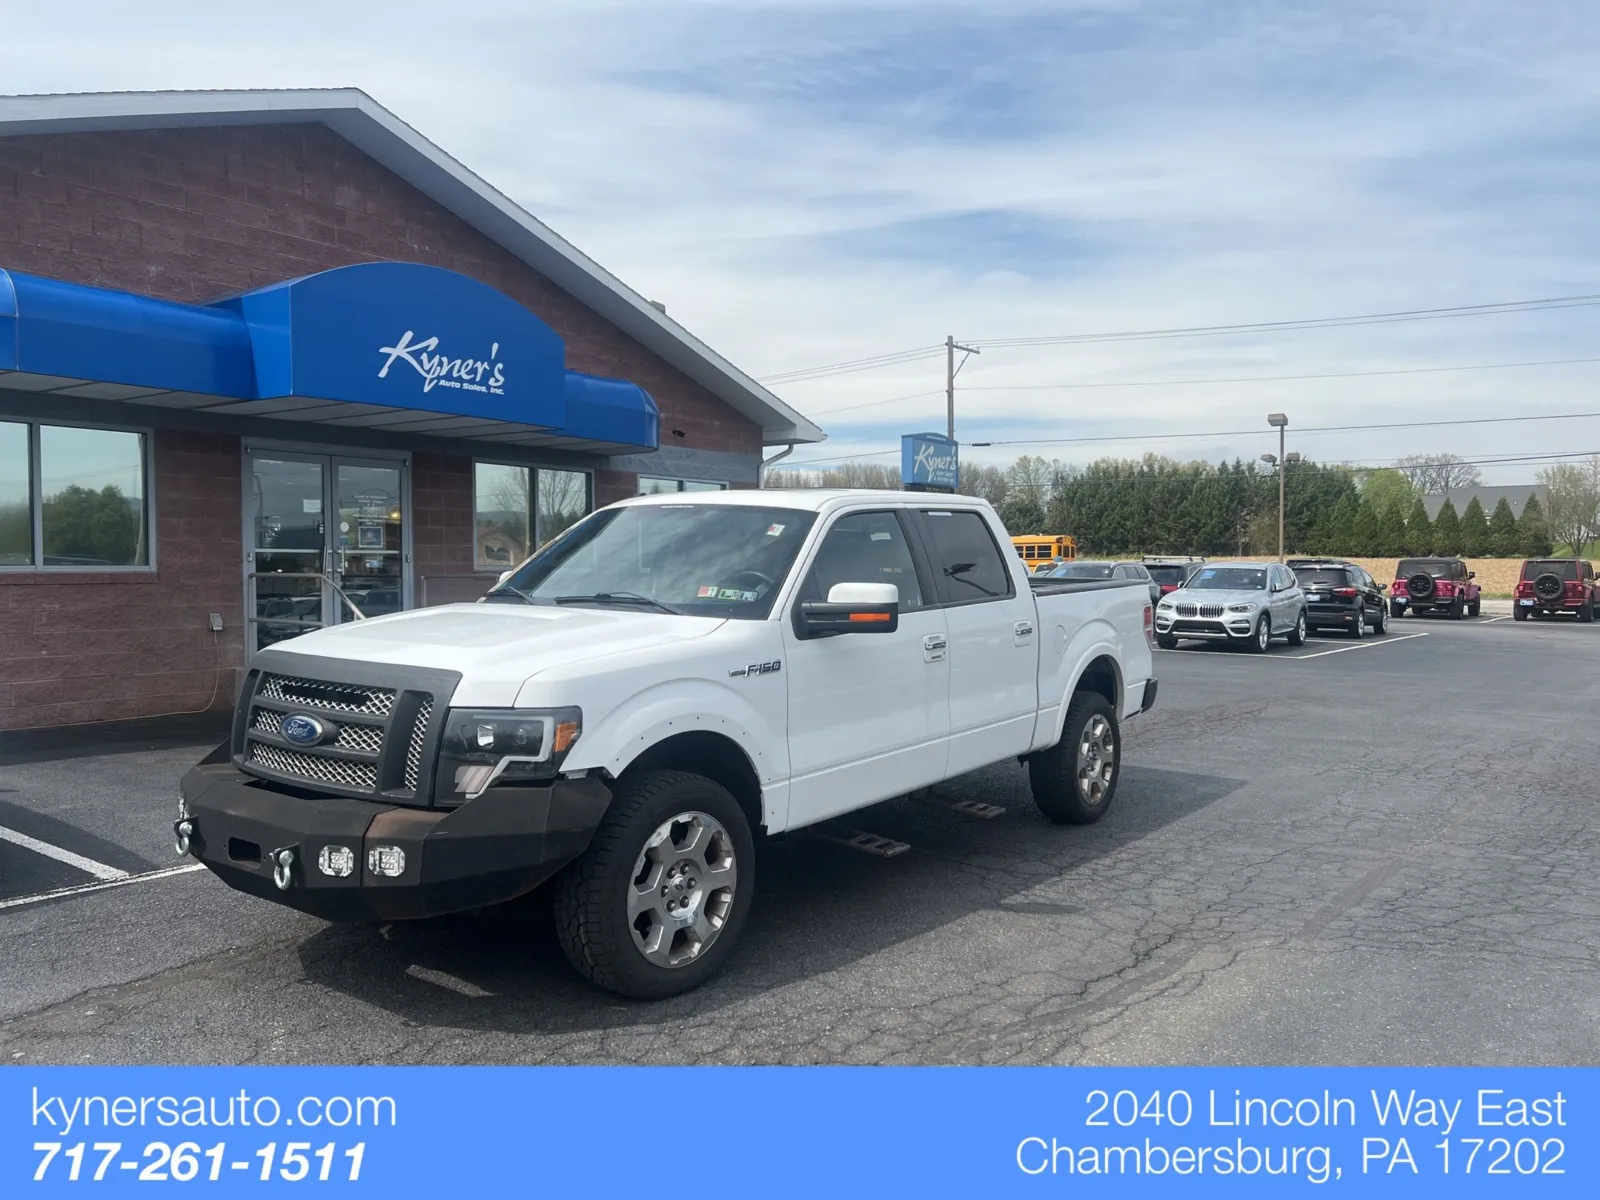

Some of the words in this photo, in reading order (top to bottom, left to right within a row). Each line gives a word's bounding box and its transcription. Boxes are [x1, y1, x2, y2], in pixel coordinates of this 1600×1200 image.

[378, 330, 505, 393] Kyner's
[439, 379, 461, 389] Auto
[462, 382, 488, 393] Sales,
[914, 444, 956, 482] Kyner's
[744, 660, 781, 677] F-150
[287, 719, 311, 737] Ford
